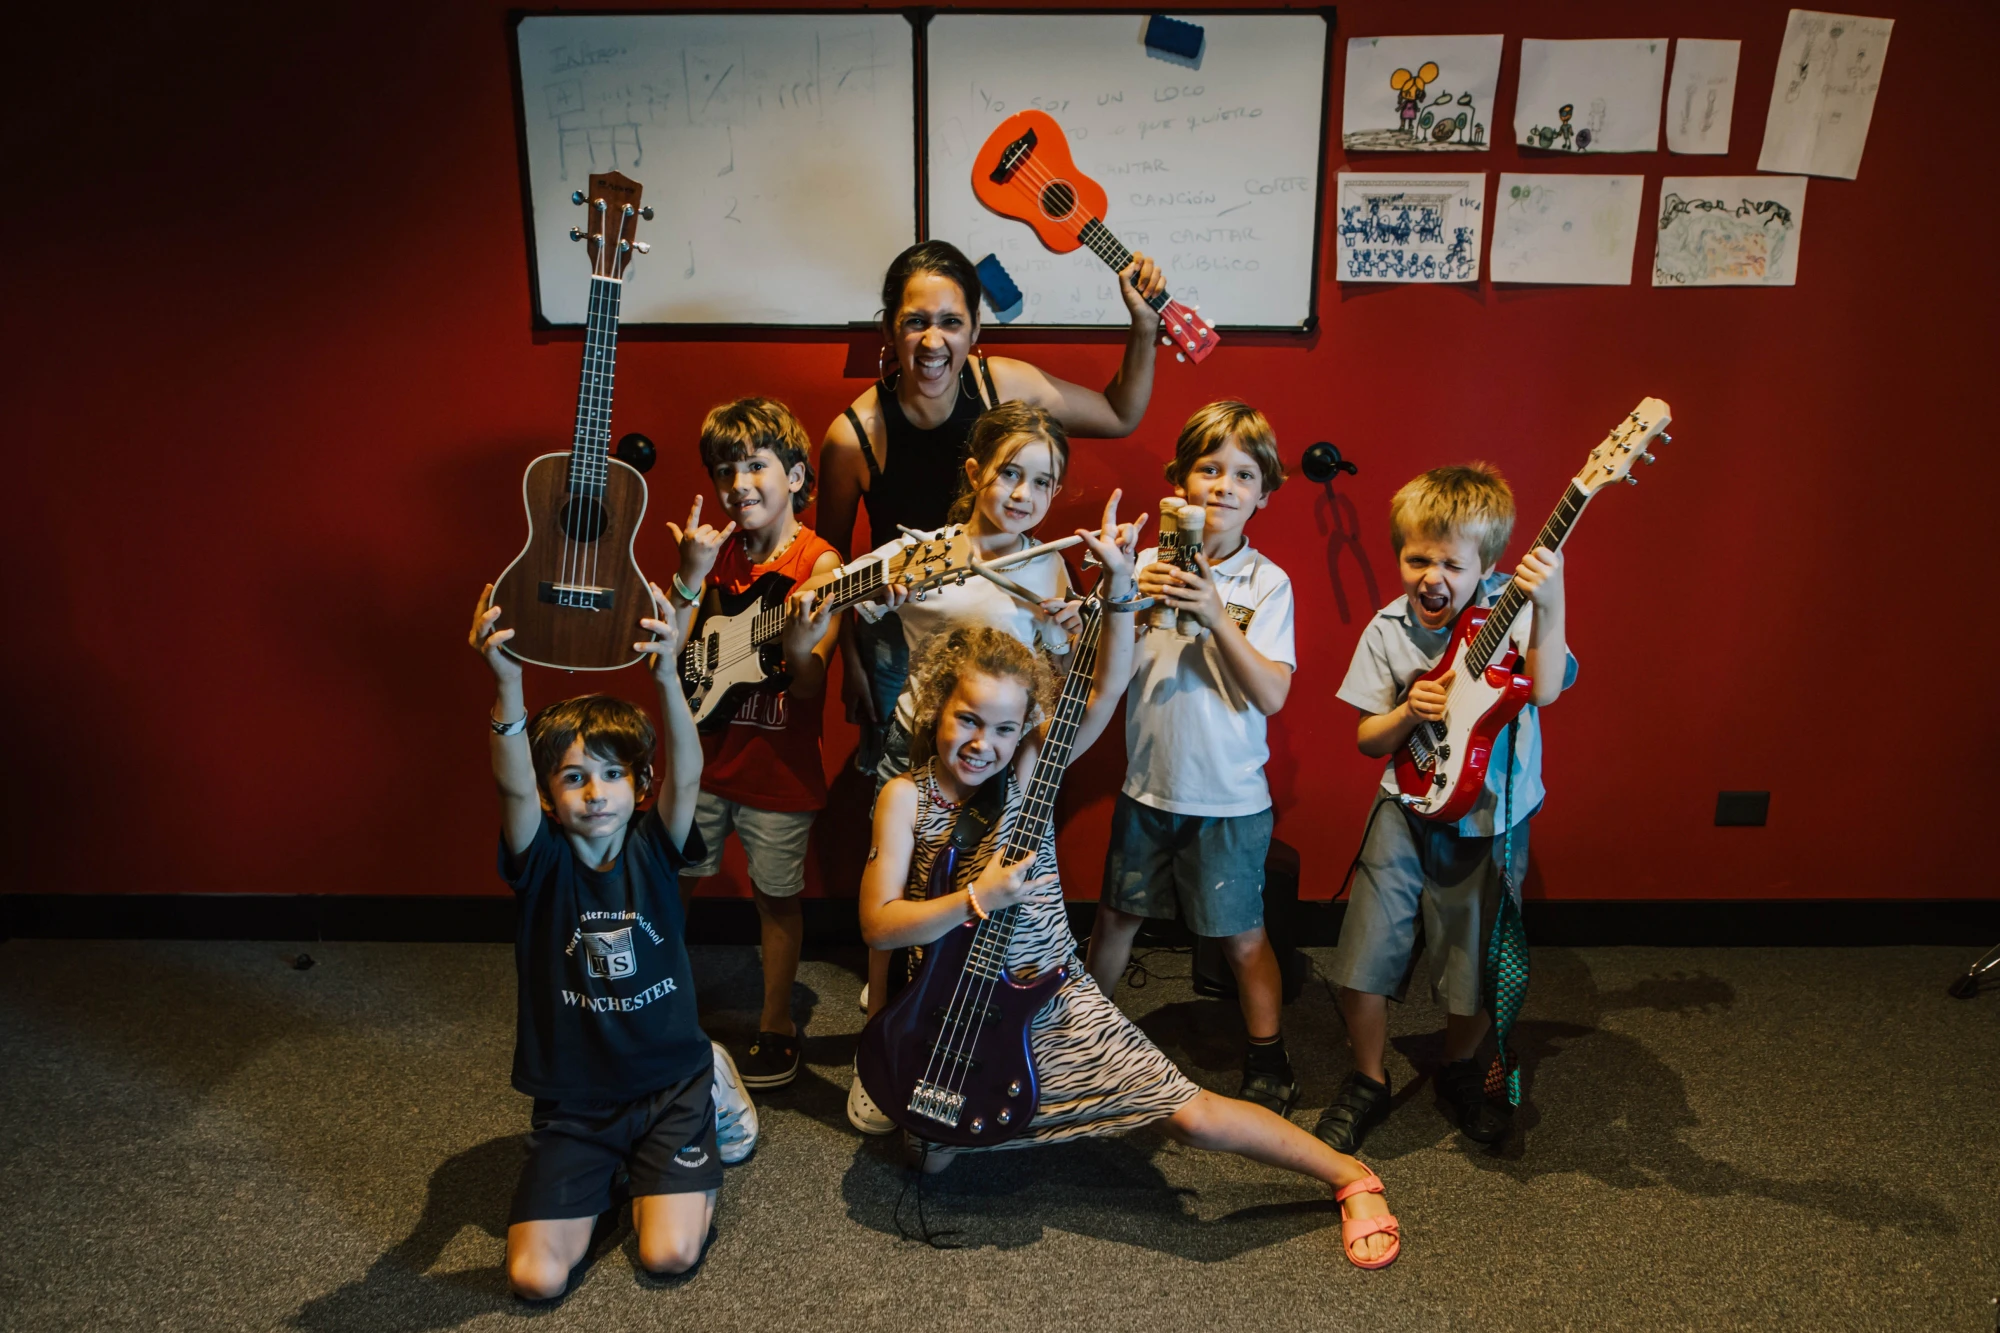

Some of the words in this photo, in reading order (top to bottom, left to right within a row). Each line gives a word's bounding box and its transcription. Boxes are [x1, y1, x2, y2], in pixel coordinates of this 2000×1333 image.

[1097, 91, 1124, 107] UN
[1153, 85, 1205, 102] LOCO
[1169, 227, 1263, 244] CANTAR
[561, 977, 678, 1013] WINCHESTER
